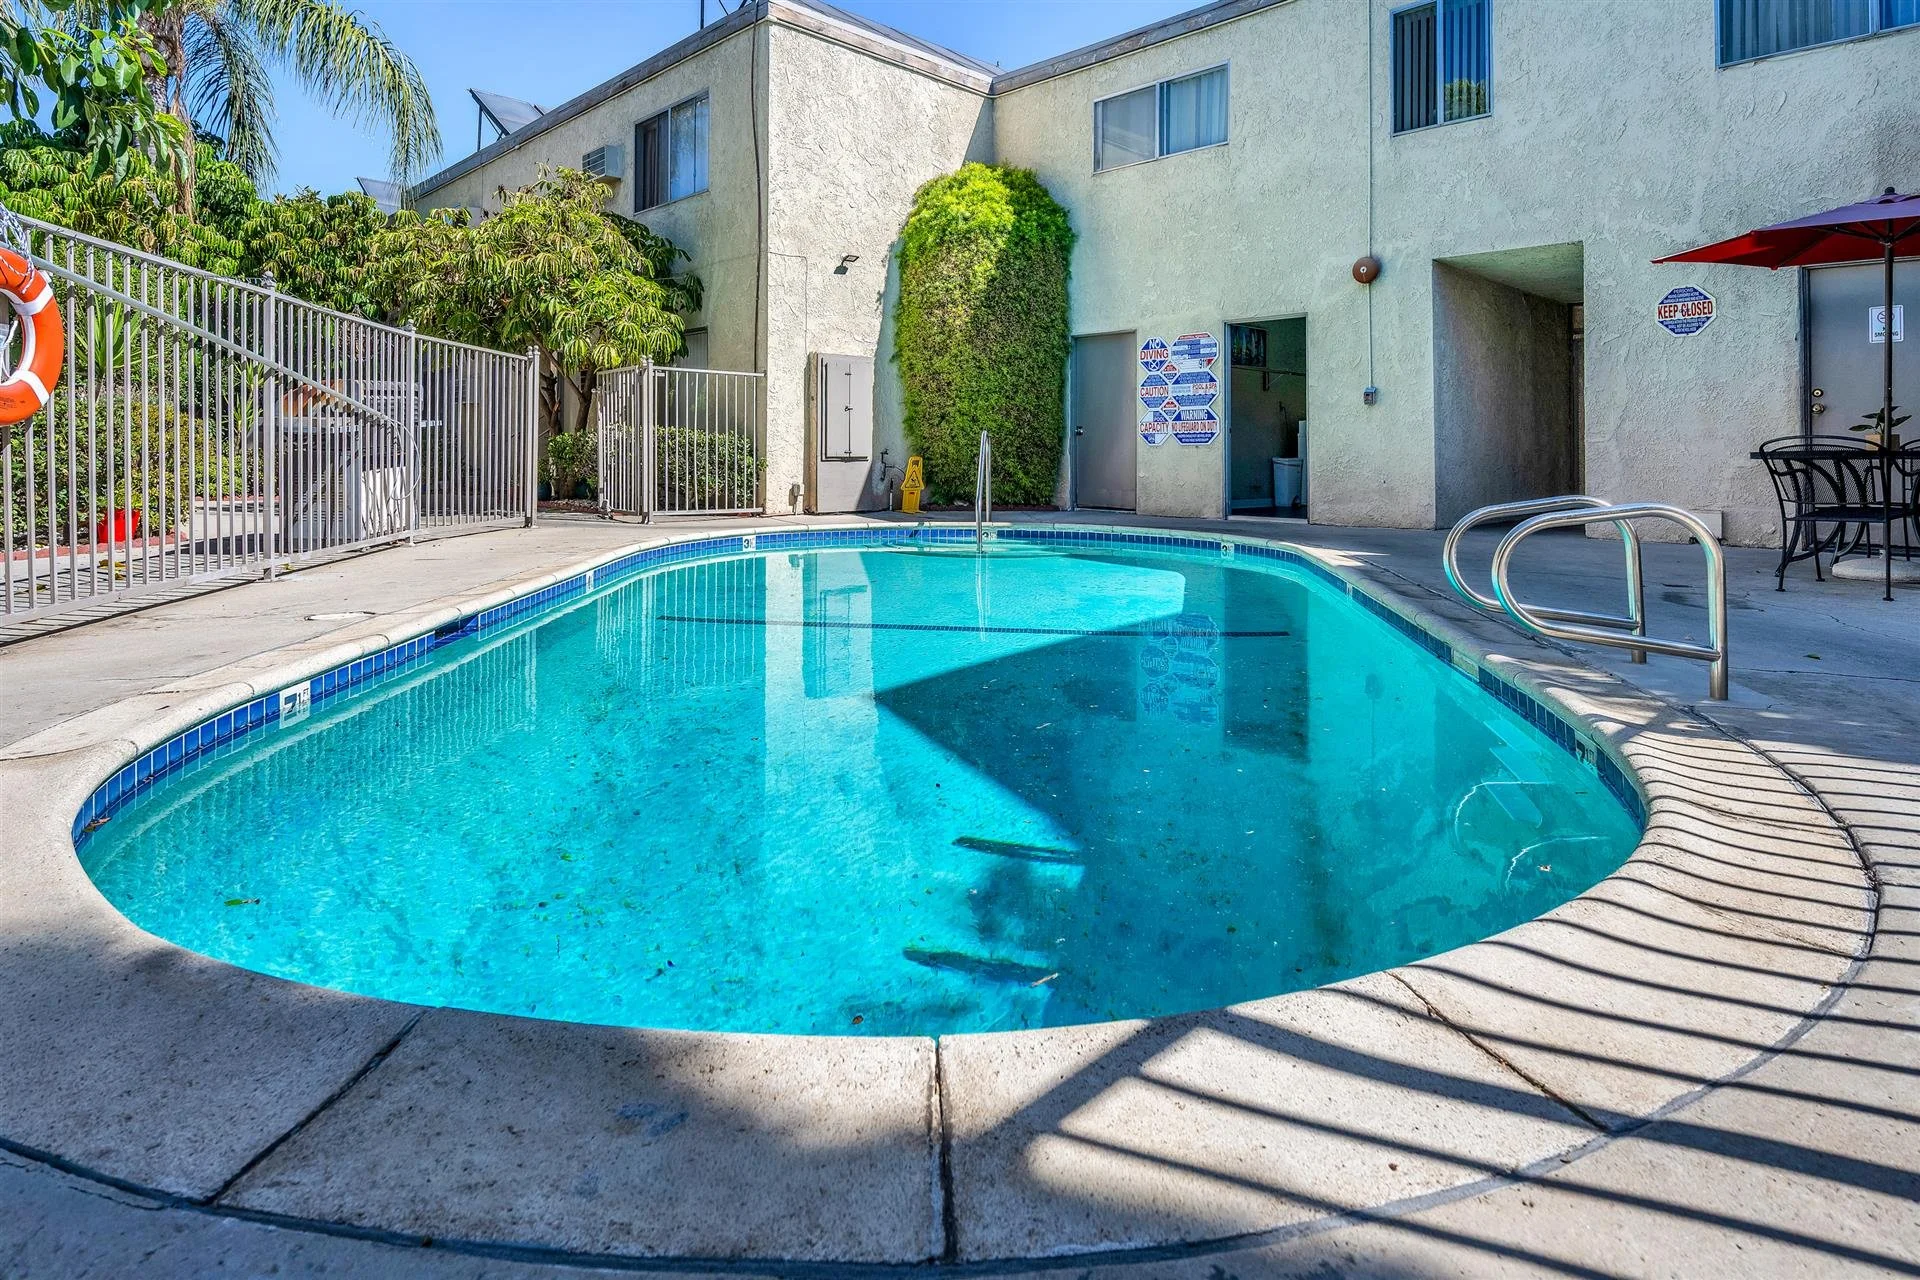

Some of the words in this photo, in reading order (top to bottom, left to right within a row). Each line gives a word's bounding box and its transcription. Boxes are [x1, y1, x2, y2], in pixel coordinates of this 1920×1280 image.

[1658, 305, 1678, 320] KEEP
[1681, 301, 1713, 317] CLOSED
[1149, 338, 1161, 349] NO
[1140, 348, 1169, 360] DIVING
[1140, 386, 1169, 397] CAUTION
[1181, 409, 1208, 420] WARNING
[1140, 422, 1169, 433] CAPACITY
[1172, 421, 1178, 432] NO
[1178, 420, 1199, 432] LIFEGUARD
[1200, 420, 1206, 431] ON
[1207, 420, 1217, 431] DUTY
[744, 538, 750, 548] 3
